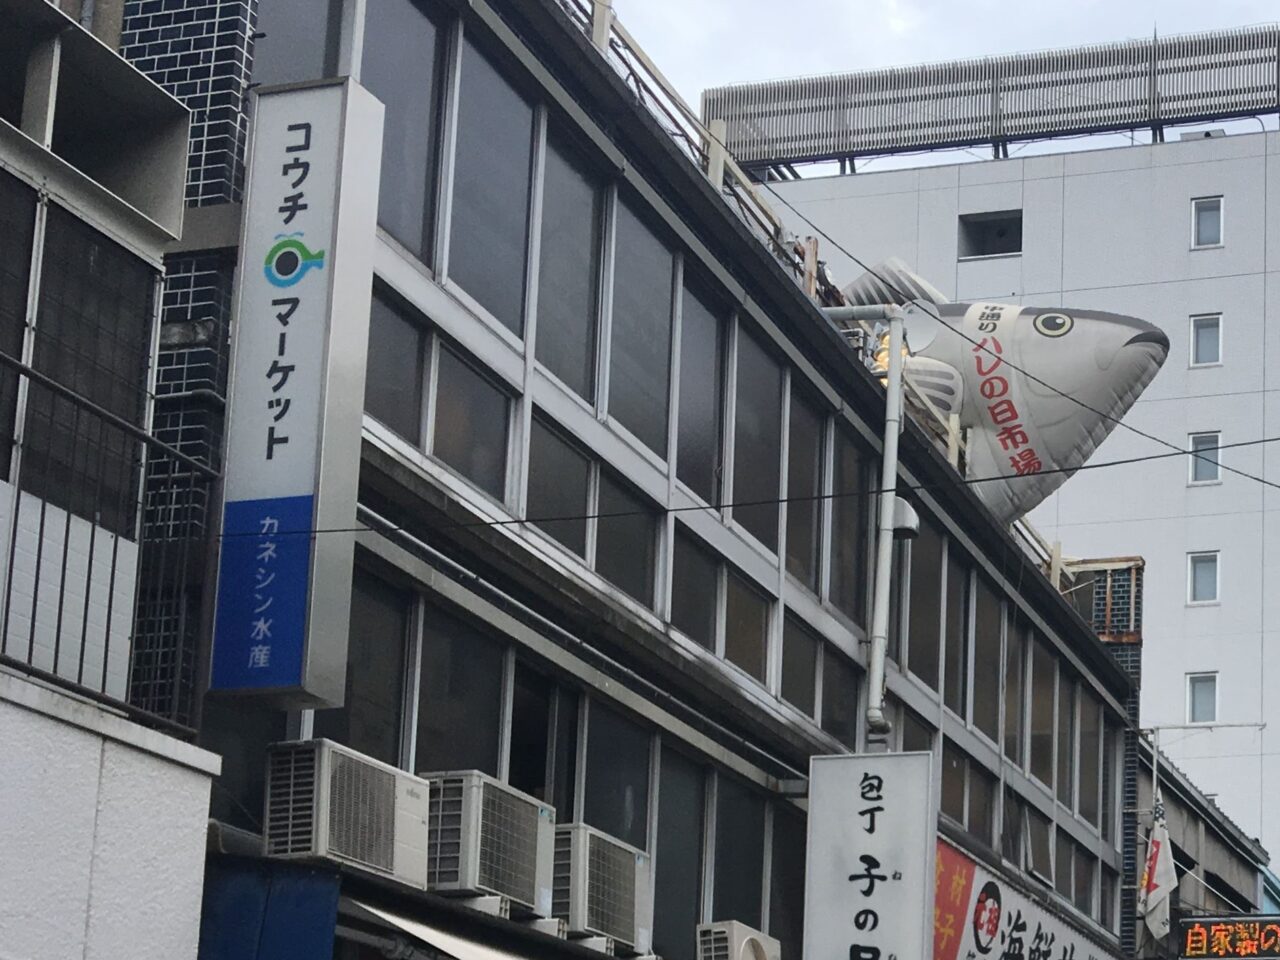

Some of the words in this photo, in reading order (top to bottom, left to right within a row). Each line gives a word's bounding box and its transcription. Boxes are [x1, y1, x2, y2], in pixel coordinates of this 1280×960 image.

[278, 121, 313, 226] コウチ
[264, 296, 300, 461] マーケット
[972, 335, 1042, 476] ハレの日市場
[247, 515, 278, 669] カネシン水産
[858, 772, 884, 835] 包丁
